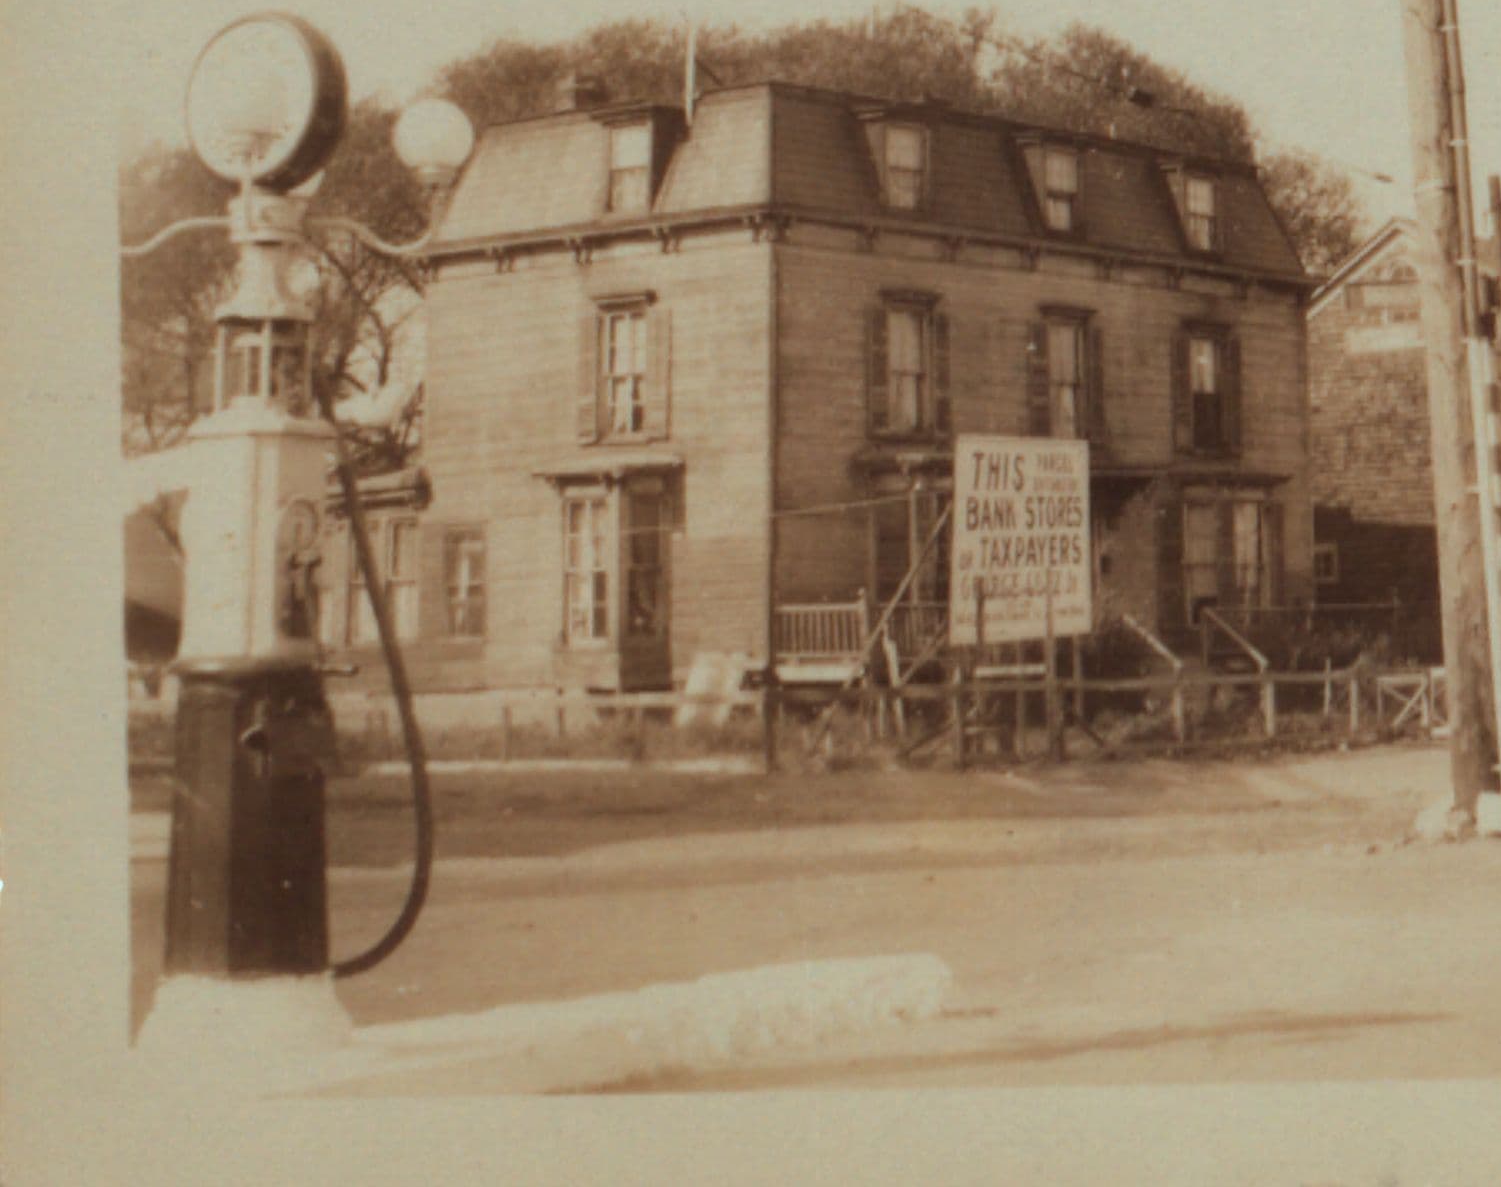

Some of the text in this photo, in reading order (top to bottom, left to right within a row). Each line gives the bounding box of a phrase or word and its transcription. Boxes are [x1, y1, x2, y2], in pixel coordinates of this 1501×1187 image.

[972, 452, 1025, 492] THIS
[966, 495, 1082, 532] BANK STORES
[980, 534, 1082, 568] TAXPAYERS
